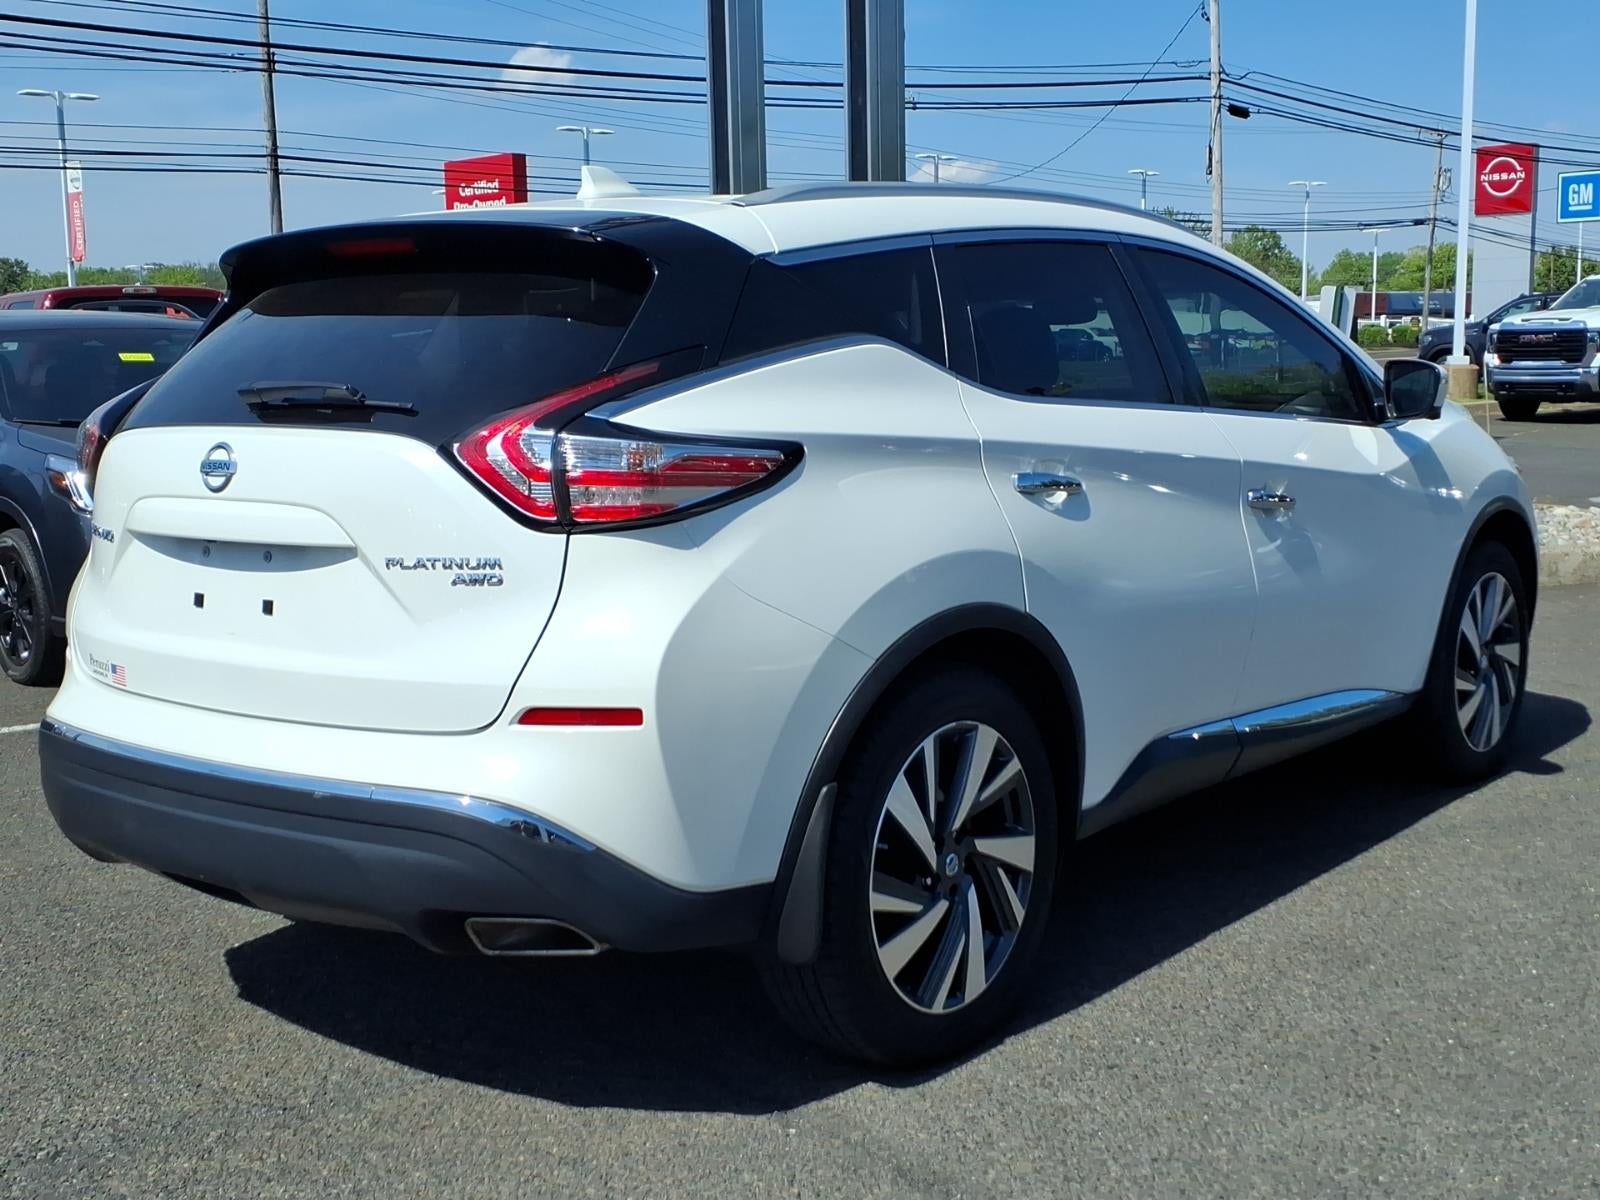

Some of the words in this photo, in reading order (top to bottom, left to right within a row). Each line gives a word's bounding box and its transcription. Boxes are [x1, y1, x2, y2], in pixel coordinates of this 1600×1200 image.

[1480, 171, 1526, 182] NISSAN
[458, 178, 499, 197] Certified
[1568, 182, 1594, 205] GM
[73, 200, 84, 250] CERTIFIED
[202, 462, 231, 471] NISSAN
[384, 557, 504, 571] PLATINUM
[450, 572, 504, 587] AWD
